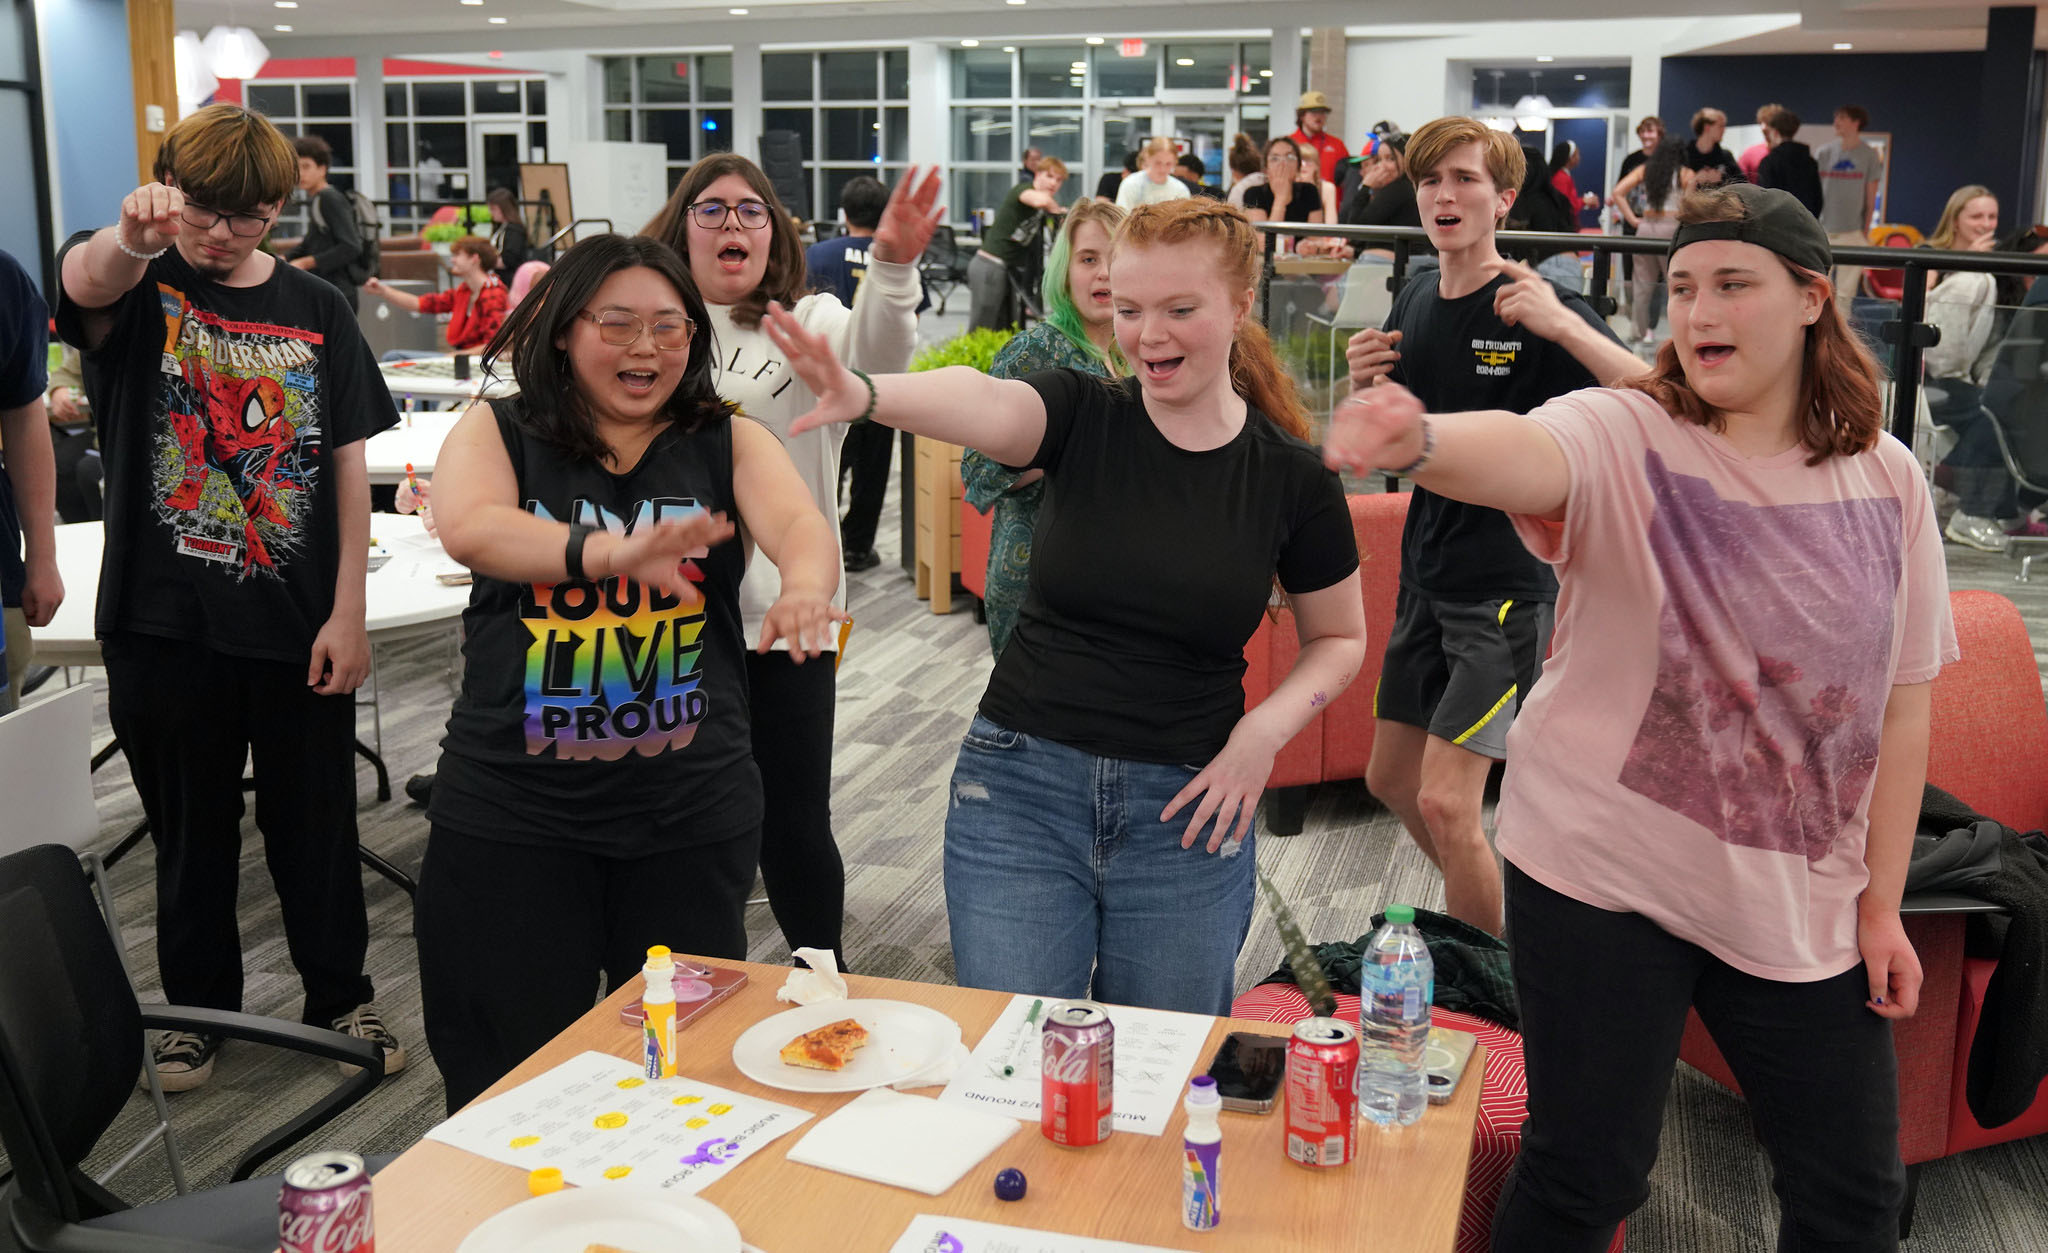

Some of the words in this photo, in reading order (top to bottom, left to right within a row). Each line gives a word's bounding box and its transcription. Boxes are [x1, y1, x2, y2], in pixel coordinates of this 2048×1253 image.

[182, 535, 237, 555] TORMENT
[540, 612, 707, 698] LIVE
[541, 688, 709, 742] PROUD
[965, 1090, 1018, 1106] ROUND
